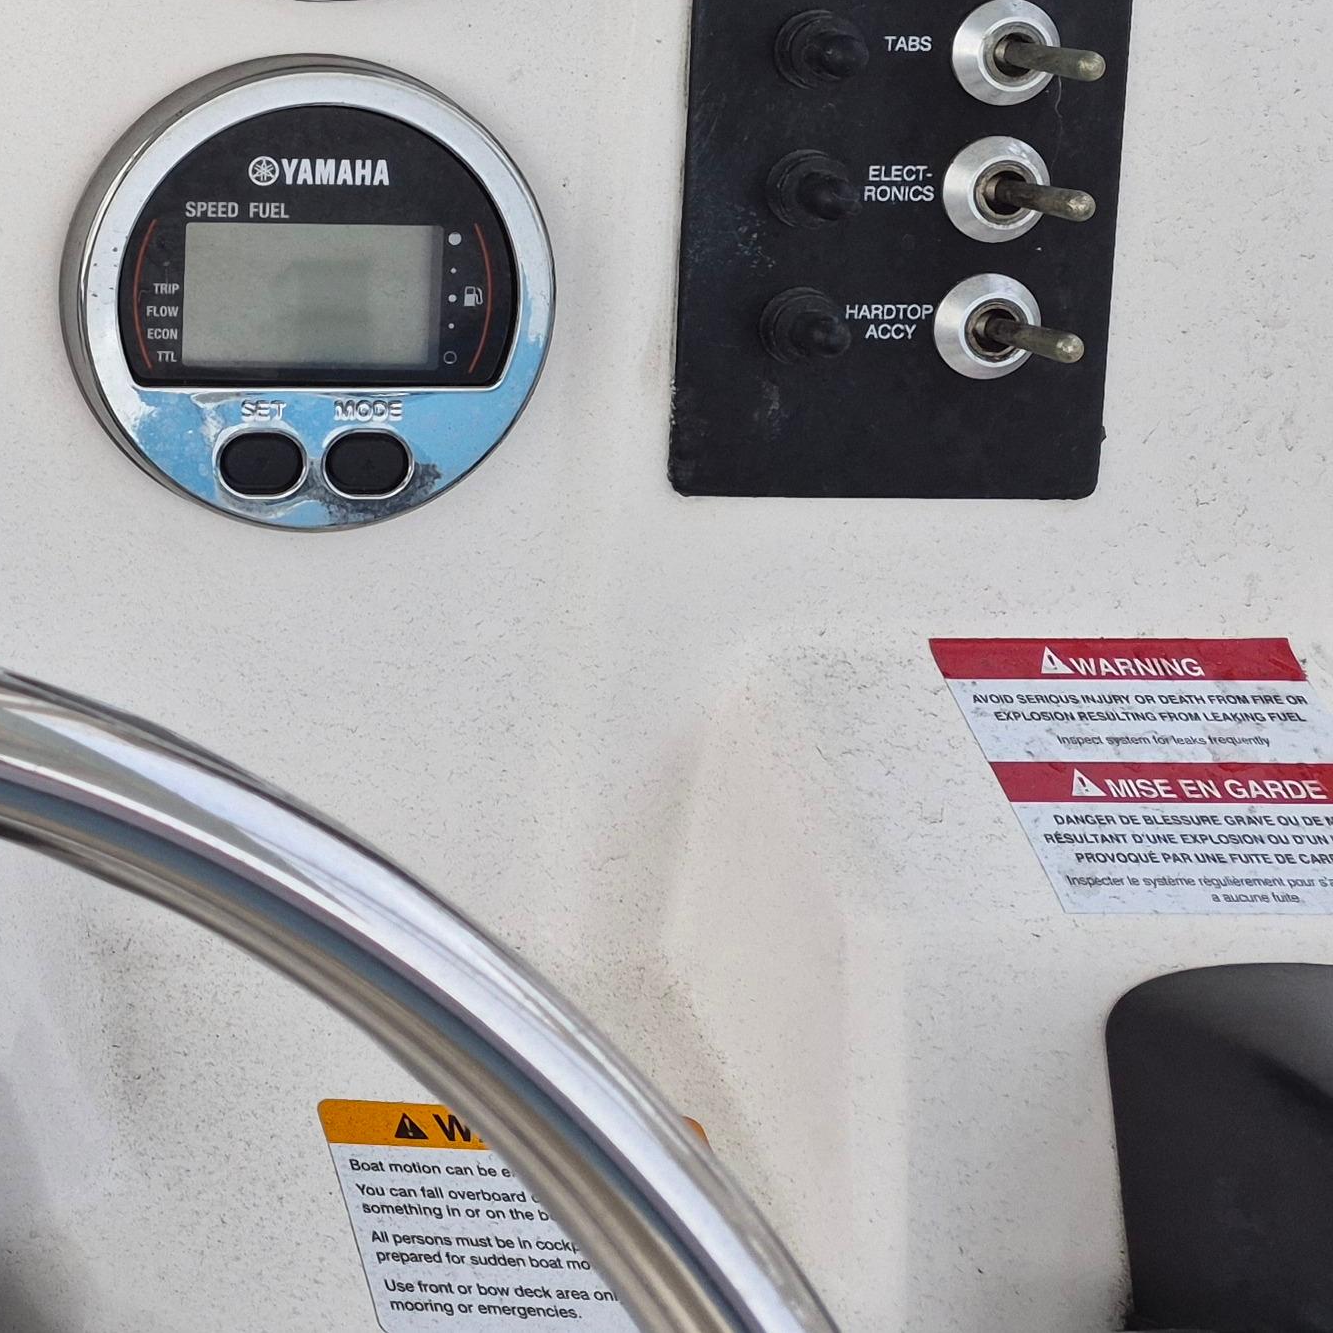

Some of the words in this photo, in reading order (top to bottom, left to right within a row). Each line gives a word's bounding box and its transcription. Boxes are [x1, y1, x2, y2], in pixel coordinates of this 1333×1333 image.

[884, 36, 932, 52] TABS
[280, 159, 390, 186] YAMAHA
[868, 166, 933, 182] ELECT-
[864, 186, 935, 202] RONICS
[185, 201, 239, 219] SPEED
[249, 202, 290, 219] FUEL
[153, 282, 180, 296] TRIP
[146, 305, 179, 318] FLOW
[845, 304, 933, 320] HARDTOP
[147, 328, 178, 341] ECON
[865, 324, 917, 340] ACCY
[157, 350, 178, 363] TTL
[240, 400, 286, 420] SET
[334, 401, 403, 422] MODE
[1069, 657, 1205, 677] WARNING
[973, 694, 1014, 704] AVOID
[1016, 694, 1079, 705] SERIOUS
[1081, 695, 1131, 705] INJURY
[1134, 695, 1155, 705] OR
[1157, 695, 1205, 705] DEATH
[1208, 695, 1250, 705] FROM
[1251, 695, 1284, 705] FIRE
[1284, 695, 1308, 705] OR
[994, 711, 1075, 722] EXPLOSION
[1077, 712, 1156, 722] RESULTING
[1160, 712, 1203, 722] FROM
[1204, 712, 1268, 722] LEAKING
[1269, 712, 1307, 722] FUEL
[1057, 734, 1102, 747] Inspect
[1105, 735, 1150, 747] system
[1152, 735, 1170, 745] for
[1171, 735, 1206, 745] leaks
[1208, 735, 1269, 747] frequently
[1104, 778, 1178, 798] MISE
[1177, 779, 1222, 799] EN
[1224, 779, 1329, 800] GARDE
[1053, 814, 1116, 825] DANGER
[1118, 815, 1141, 825] DE
[1142, 815, 1222, 826] BLESSURE
[1224, 815, 1275, 826] GRAVE
[1277, 816, 1300, 826] OU
[1301, 816, 1324, 826] DE
[1043, 831, 1128, 844] RÉSULTANT
[1131, 833, 1178, 844] D'UNE
[1180, 834, 1265, 845] EXPLOSION
[1267, 834, 1289, 845] OU
[1292, 834, 1329, 845] D'UN
[1075, 850, 1160, 863] PROVOQUÉ
[1161, 853, 1192, 863] PAR
[1194, 853, 1228, 863] UNE
[1228, 853, 1273, 864] FUITE
[1274, 853, 1297, 864] DE
[1066, 874, 1125, 888] Inspecter
[1126, 875, 1140, 886] le
[1288, 877, 1315, 888] pour
[1223, 893, 1270, 903] aucune
[349, 1158, 385, 1172] Boat
[389, 1161, 441, 1175] motion
[445, 1165, 473, 1176] can
[477, 1165, 497, 1178] be
[356, 1183, 385, 1196] You
[389, 1187, 417, 1198] can
[420, 1186, 444, 1199] fall
[448, 1189, 526, 1203] overboard
[362, 1202, 443, 1219] something
[446, 1205, 461, 1217] in
[465, 1207, 481, 1219] or
[485, 1209, 506, 1220] on
[509, 1208, 535, 1221] the
[372, 1230, 389, 1243] All
[392, 1233, 452, 1246] persons
[455, 1236, 493, 1248] must
[495, 1236, 515, 1249] be
[517, 1237, 532, 1249] in
[376, 1251, 442, 1264] prepared
[445, 1252, 465, 1264] for
[470, 1254, 526, 1267] sudden
[528, 1256, 564, 1269] boat
[384, 1279, 415, 1292] Use
[417, 1280, 454, 1294] front
[457, 1284, 472, 1294] or
[476, 1283, 509, 1296] bow
[514, 1285, 552, 1299] deck
[555, 1289, 590, 1300] area
[390, 1299, 454, 1316] mooring
[457, 1304, 473, 1314] or
[477, 1304, 582, 1320] emergencies.
